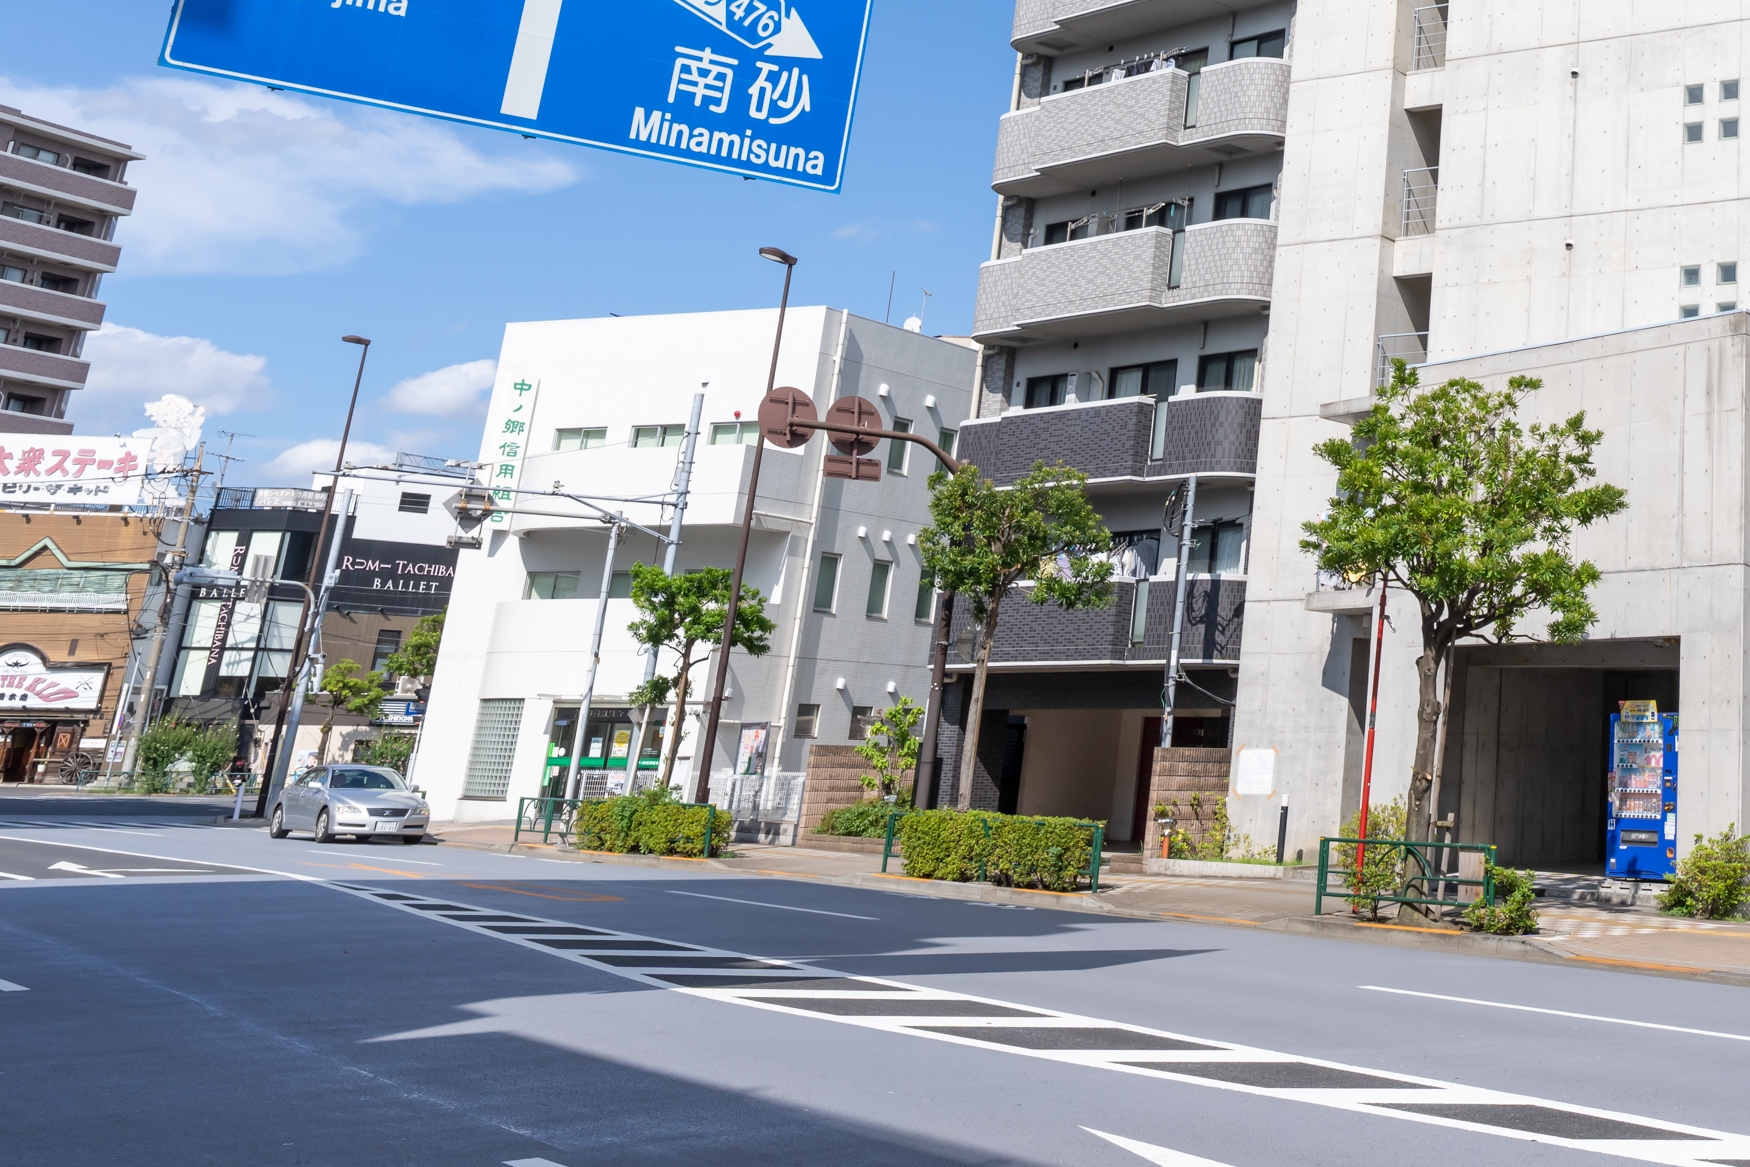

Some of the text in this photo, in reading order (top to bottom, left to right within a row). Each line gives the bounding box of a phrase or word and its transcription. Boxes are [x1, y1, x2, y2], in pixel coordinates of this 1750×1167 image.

[667, 46, 811, 124] 南砂
[629, 106, 825, 176] Minamisuna
[373, 578, 439, 593] BALLET
[395, 560, 455, 577] TACHIBA
[199, 588, 246, 598] BALLE
[208, 598, 234, 666] TACHIBANA
